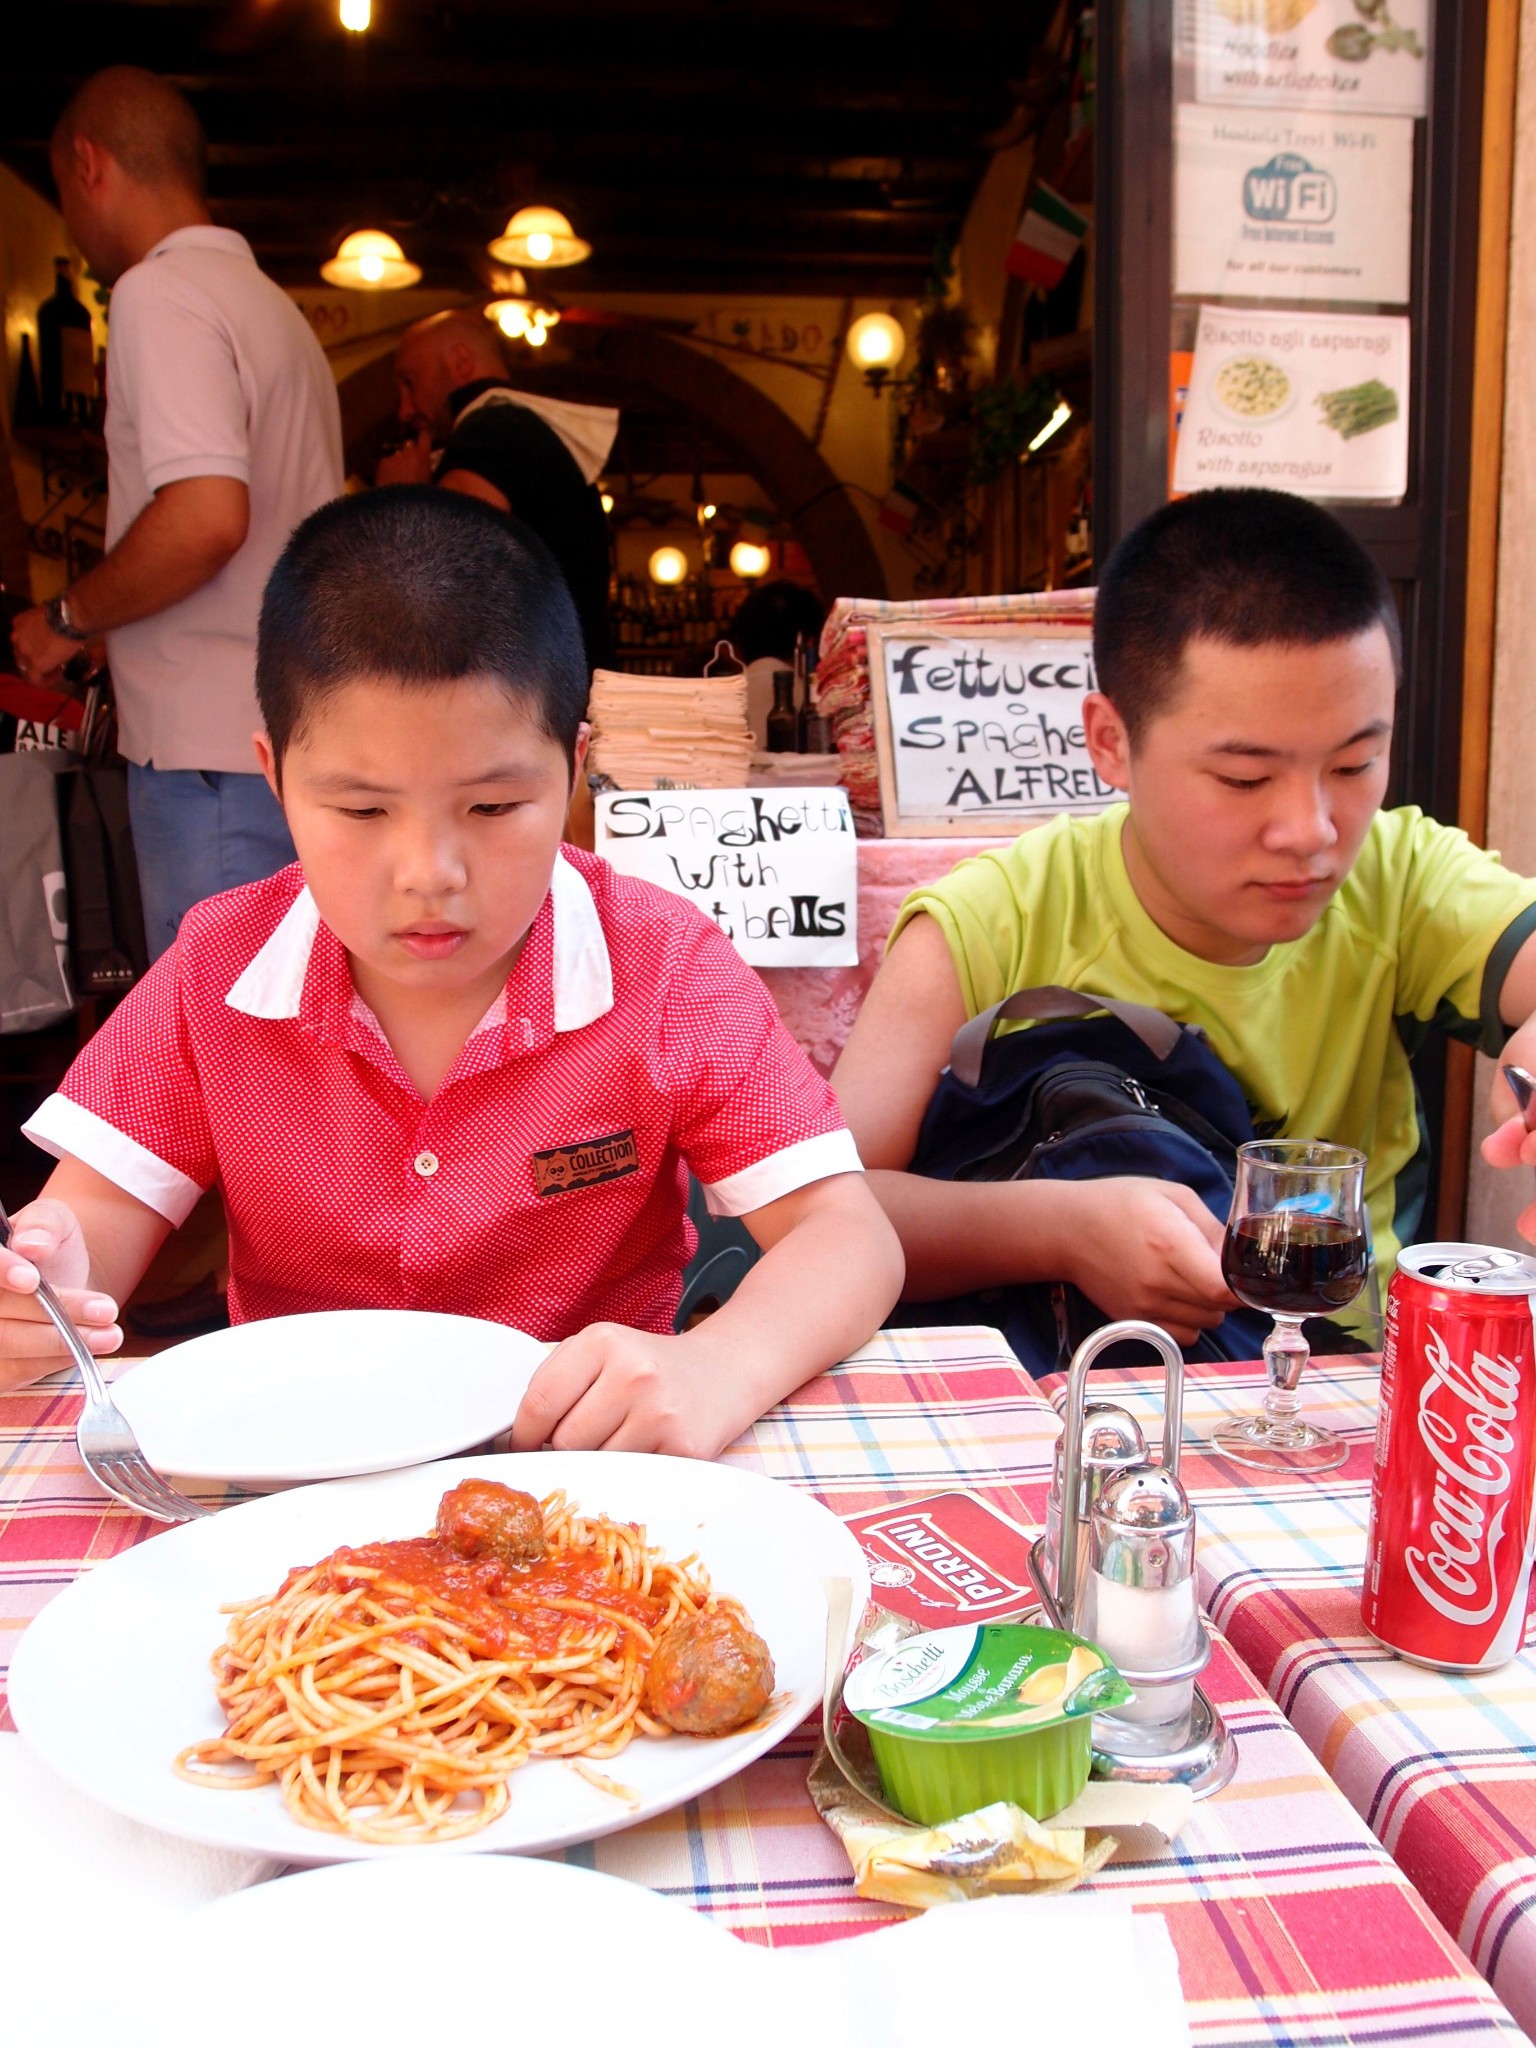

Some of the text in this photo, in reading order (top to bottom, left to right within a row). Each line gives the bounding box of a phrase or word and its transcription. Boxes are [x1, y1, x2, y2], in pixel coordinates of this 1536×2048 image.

[1202, 327, 1392, 356] Risotto agli asparagi
[1197, 428, 1332, 480] Risotto with asparagus
[1405, 1323, 1521, 1625] Coca-Cola
[888, 1523, 1004, 1601] PERONI
[873, 1643, 945, 1698] Boschetti
[943, 1668, 991, 1703] Mousse
[986, 1654, 1034, 1697] Banana
